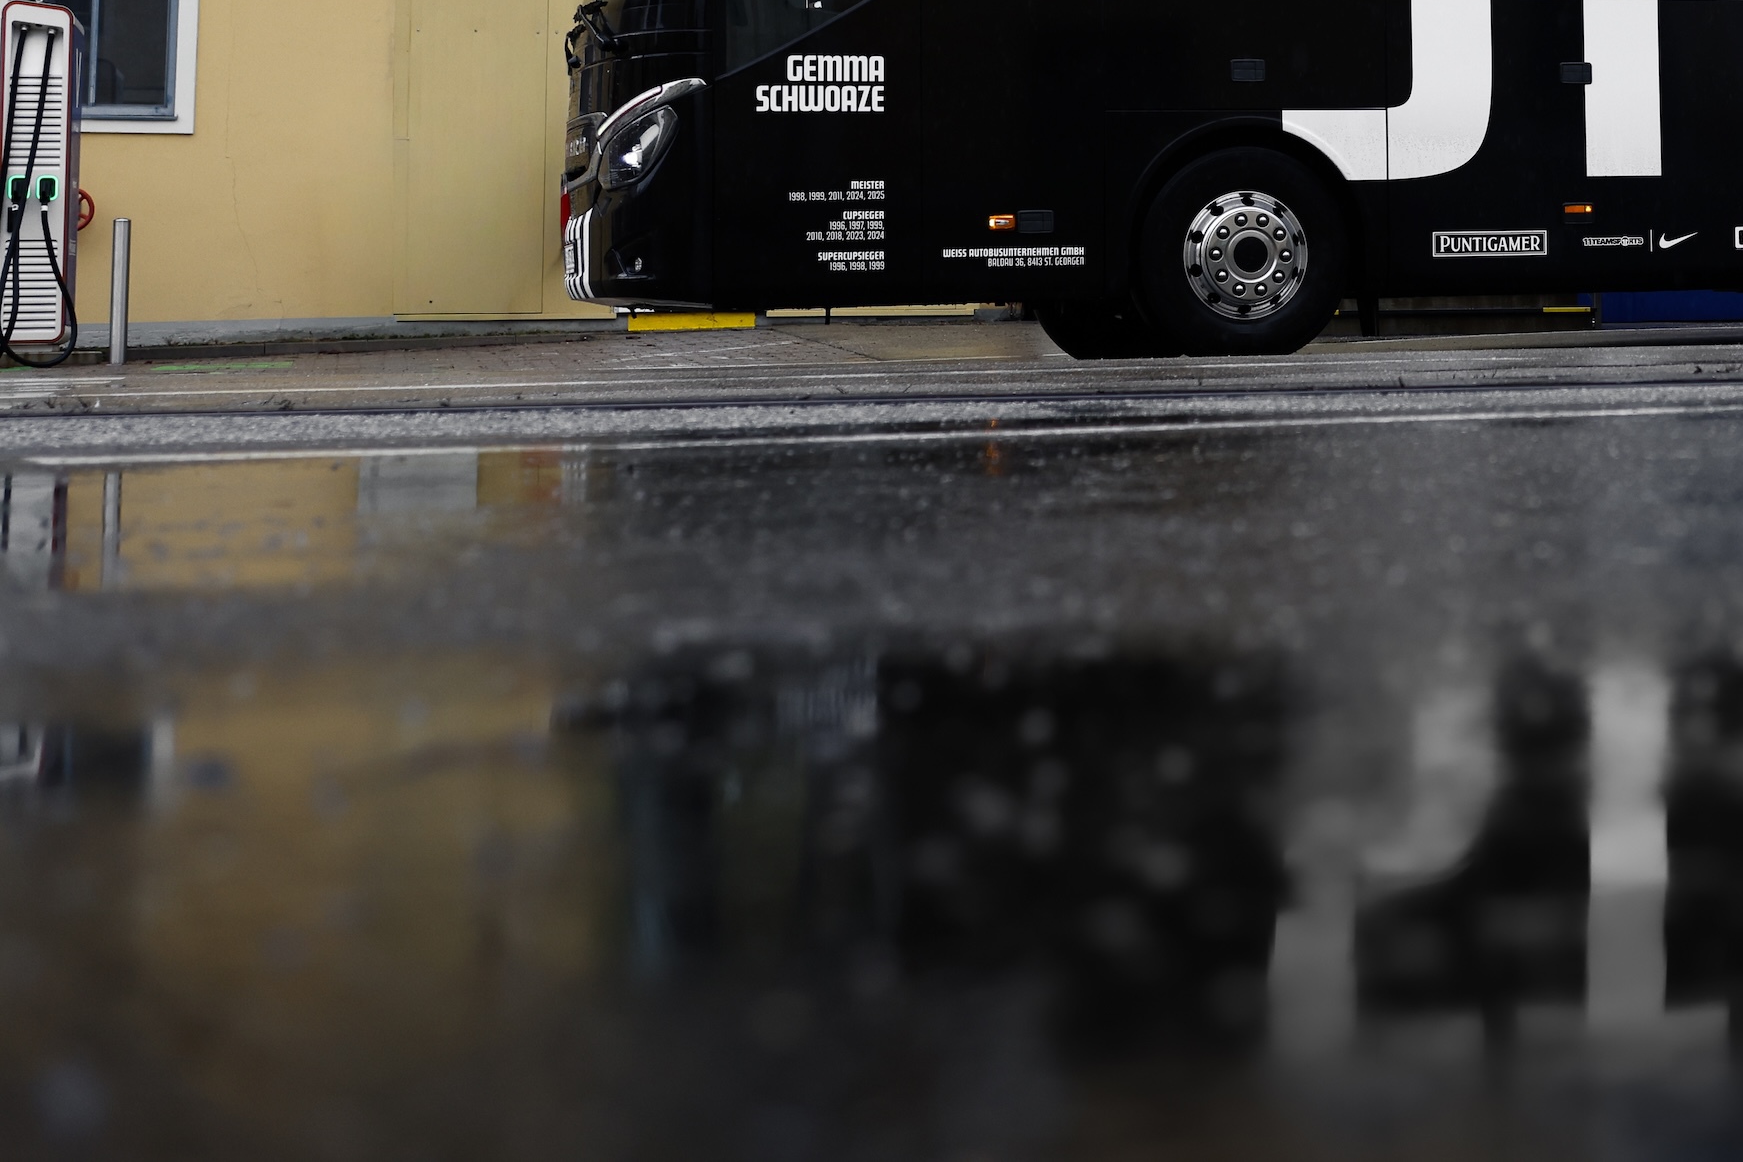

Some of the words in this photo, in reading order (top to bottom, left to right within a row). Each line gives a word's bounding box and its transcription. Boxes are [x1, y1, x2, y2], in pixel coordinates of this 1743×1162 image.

[787, 55, 884, 82] GEMMA
[756, 85, 884, 111] SCHWOAZE
[851, 181, 884, 189] MEISTER
[789, 192, 807, 201] 1998,
[809, 192, 826, 201] 1999,
[828, 192, 844, 200] 2011,
[846, 191, 865, 200] 2024,
[868, 191, 884, 199] 2025
[843, 211, 884, 220] CUPSIEGER
[830, 221, 847, 230] 1996,
[849, 221, 865, 230] 1997,
[867, 221, 884, 230] 1999,
[807, 232, 824, 241] 2010,
[826, 231, 844, 240] 2018,
[846, 231, 865, 240] 2023,
[867, 231, 884, 239] 2024
[1440, 236, 1540, 252] PUNTIGAMER
[818, 251, 884, 261] SUPERCUPSIEGER
[943, 249, 967, 257] WEISS
[969, 247, 1059, 257] AUTOBUSUNTERNEHMEN
[1061, 247, 1084, 255] GMBH
[830, 262, 847, 271] 1996,
[850, 262, 867, 271] 1998,
[869, 261, 884, 270] 1999
[1015, 258, 1025, 267] 36,
[1028, 257, 1042, 266] 8413
[1044, 257, 1053, 266] ST.
[1055, 257, 1084, 265] GEORGEN
